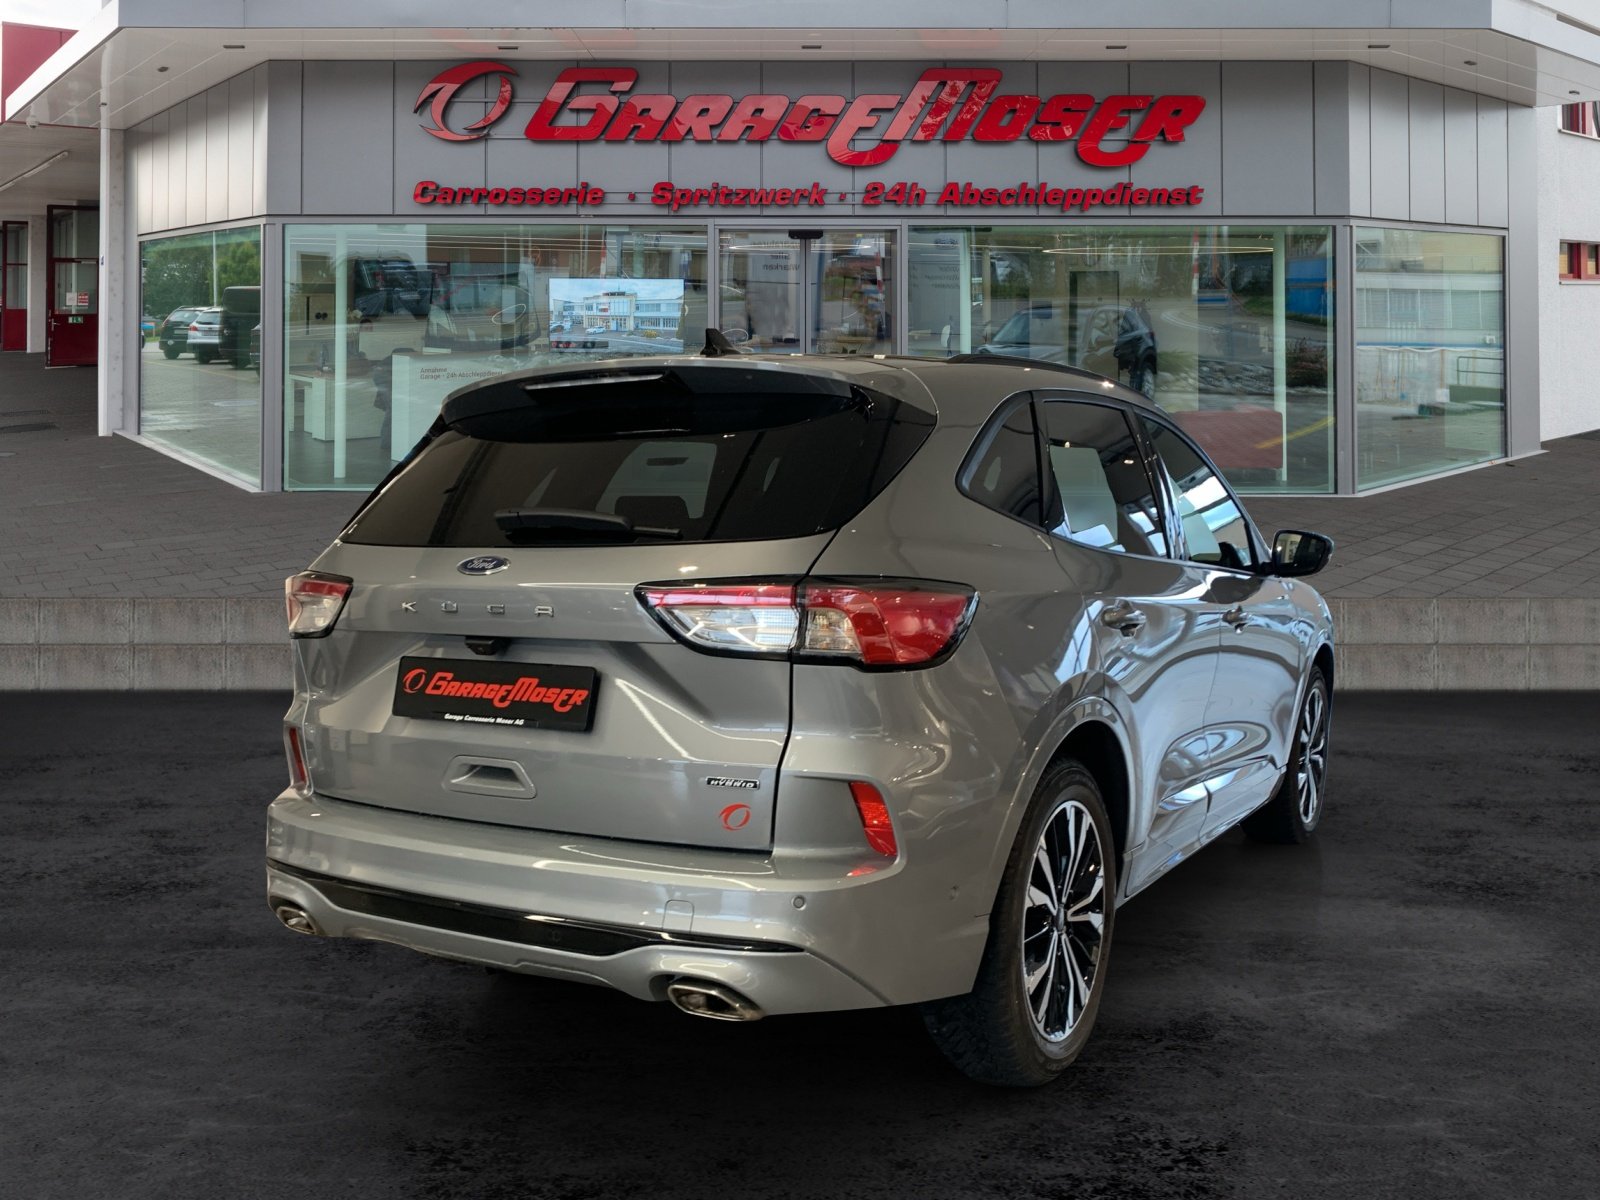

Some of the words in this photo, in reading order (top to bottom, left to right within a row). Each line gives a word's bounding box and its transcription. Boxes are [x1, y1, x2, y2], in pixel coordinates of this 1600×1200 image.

[413, 181, 604, 205] Carrosserie
[652, 181, 826, 211] Spritzwerk
[863, 181, 926, 205] 24h
[938, 181, 1204, 211] Abschleppdienst
[420, 373, 440, 381] Garage
[467, 558, 497, 569] Ford
[444, 713, 463, 721] Garage
